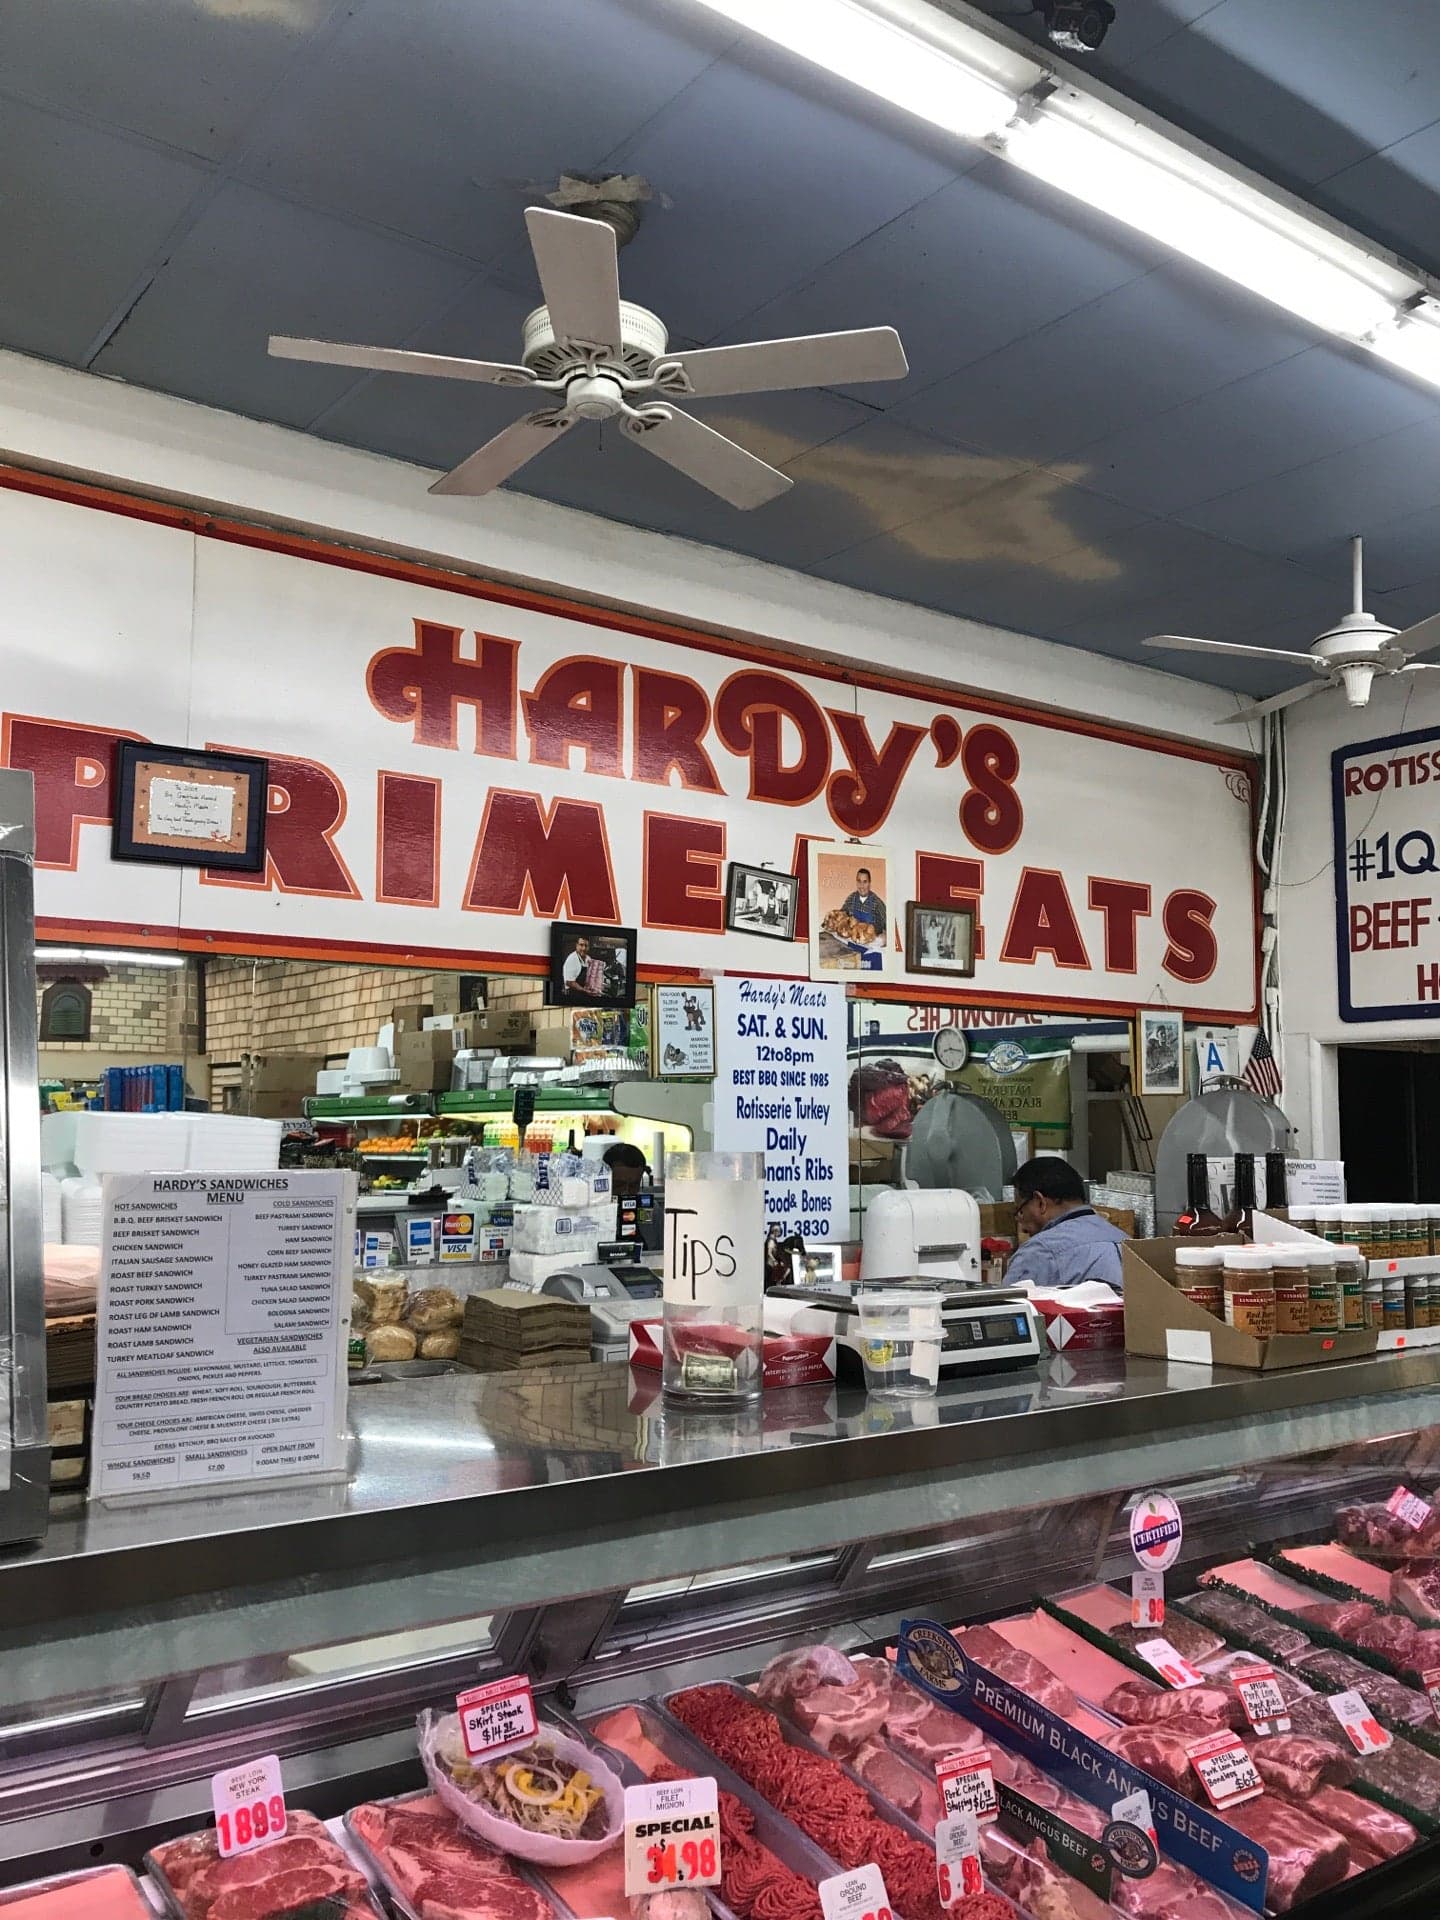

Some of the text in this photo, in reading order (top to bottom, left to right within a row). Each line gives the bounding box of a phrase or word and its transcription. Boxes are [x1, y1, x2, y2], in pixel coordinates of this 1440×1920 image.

[366, 617, 1023, 855] HARDY'S
[2, 711, 1218, 984] PRIME EATS
[1350, 898, 1432, 952] BEEF
[1417, 963, 1440, 1001] H
[739, 980, 827, 1010] Hardy's Meats
[737, 1013, 828, 1040] SAT. & SUN.
[1207, 1042, 1224, 1071] A
[733, 1069, 829, 1087] BEST BBQ SINCE 1985
[737, 1096, 830, 1126] Rotisserie Turkey
[767, 1127, 807, 1156] Daily
[805, 1157, 833, 1181] Ribs
[154, 1179, 288, 1190] HARDY'S SANDWICHES
[207, 1192, 244, 1203] MENU
[273, 1200, 290, 1208] COLD
[802, 1189, 832, 1212] Bones
[447, 1244, 467, 1254] VISA
[665, 1208, 736, 1300] Tips
[237, 1333, 323, 1345] VEGETARIAN SANDWICHES
[107, 1355, 134, 1363] TURKEY
[176, 1350, 214, 1358] SANDWICH
[1135, 1521, 1178, 1546] CERTIFIED
[481, 1700, 512, 1716] SPECIAL
[975, 1679, 1045, 1740] PREMIUM
[1049, 1727, 1103, 1779] BLACK
[1173, 1808, 1223, 1852] BEEF
[1211, 1752, 1236, 1766] SPECIAL
[229, 1775, 267, 1793] NEW YORK
[955, 1771, 980, 1786] SPECIAL
[236, 1786, 261, 1800] STEAK
[661, 1794, 679, 1802] FILET
[656, 1801, 684, 1810] MIGNON
[635, 1816, 714, 1838] SPECIAL
[1026, 1811, 1061, 1842] ANGUS
[1062, 1833, 1089, 1858] BEEF
[840, 1883, 867, 1897] GROUND
[848, 1892, 862, 1904] BEEF
